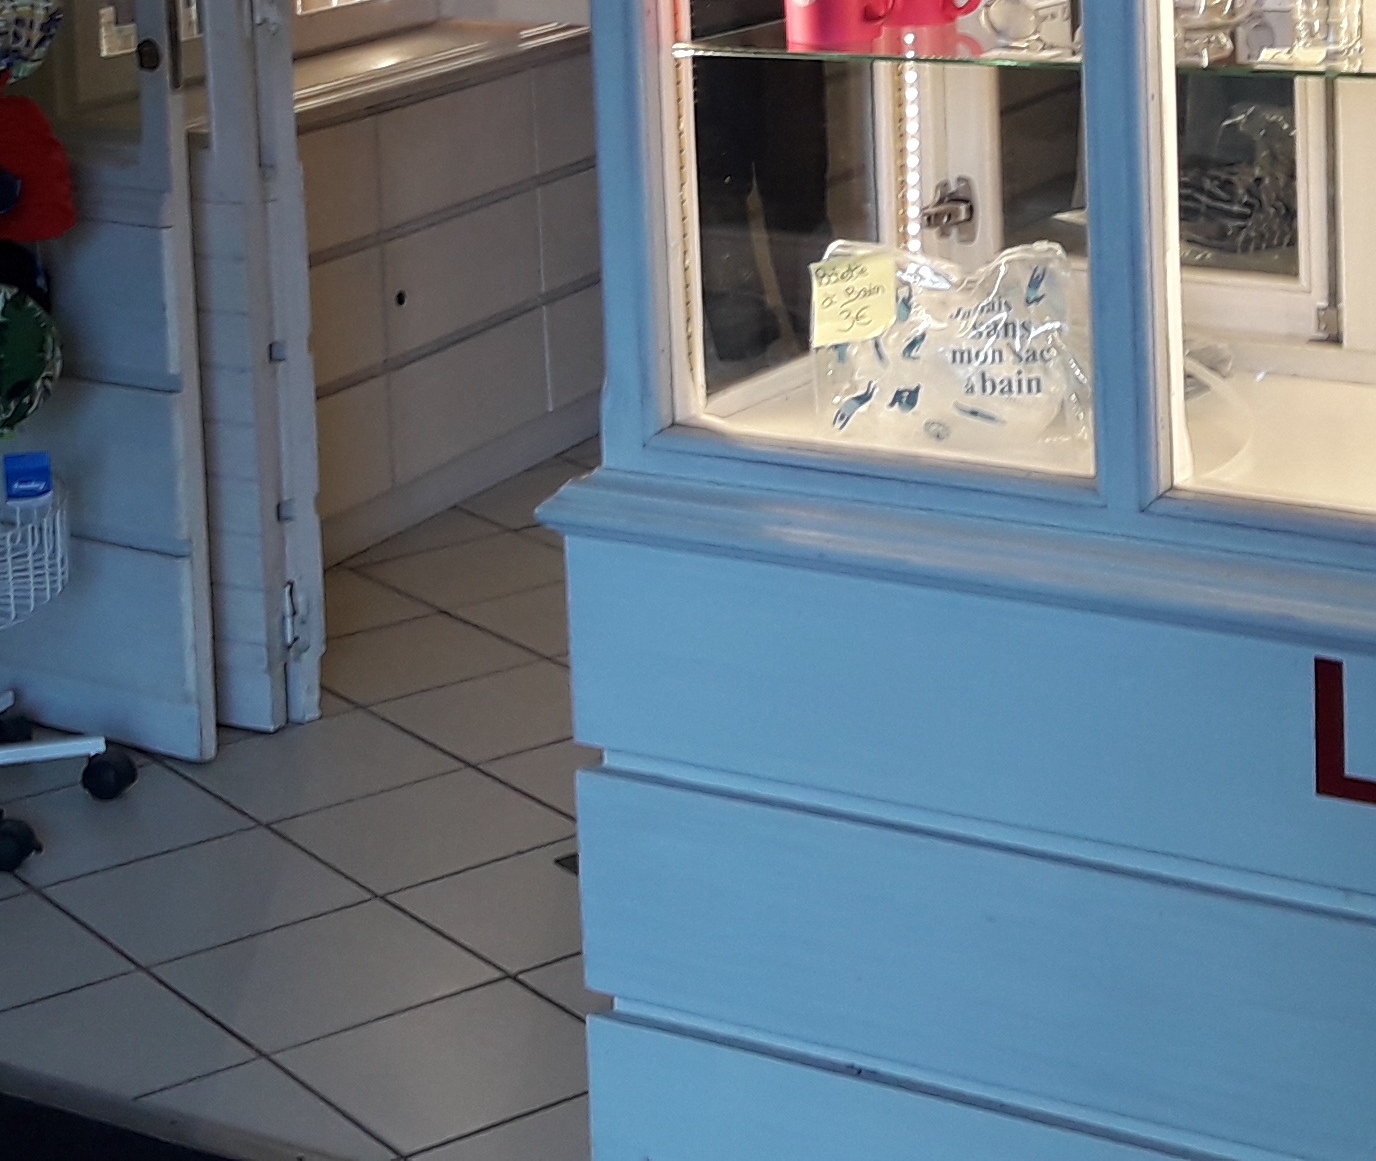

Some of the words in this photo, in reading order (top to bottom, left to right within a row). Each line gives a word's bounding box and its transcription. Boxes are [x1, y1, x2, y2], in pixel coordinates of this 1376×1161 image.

[837, 304, 873, 333] 3€
[951, 348, 1004, 365] mon
[981, 369, 1043, 395] bain
